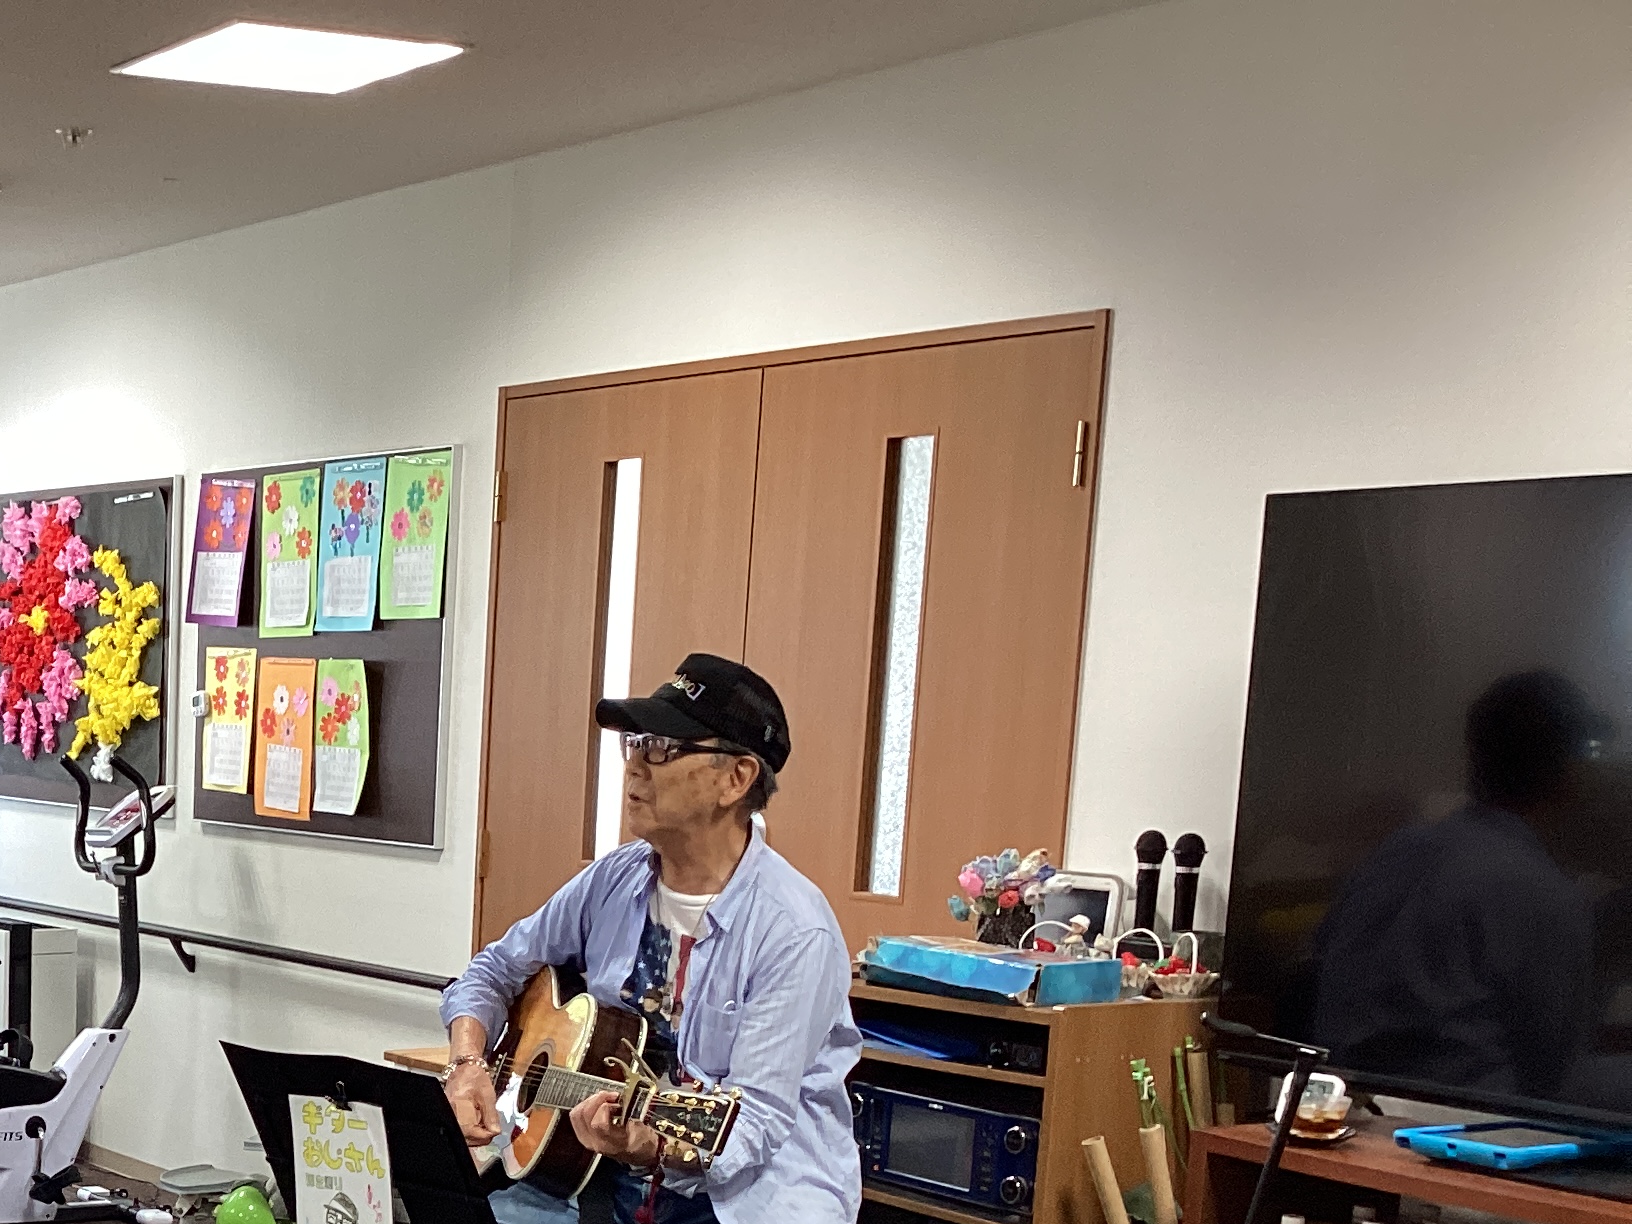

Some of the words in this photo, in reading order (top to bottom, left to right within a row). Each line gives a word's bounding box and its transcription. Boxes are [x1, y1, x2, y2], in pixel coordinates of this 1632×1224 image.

[302, 1100, 369, 1135] ギター
[302, 1136, 387, 1180] おじさん
